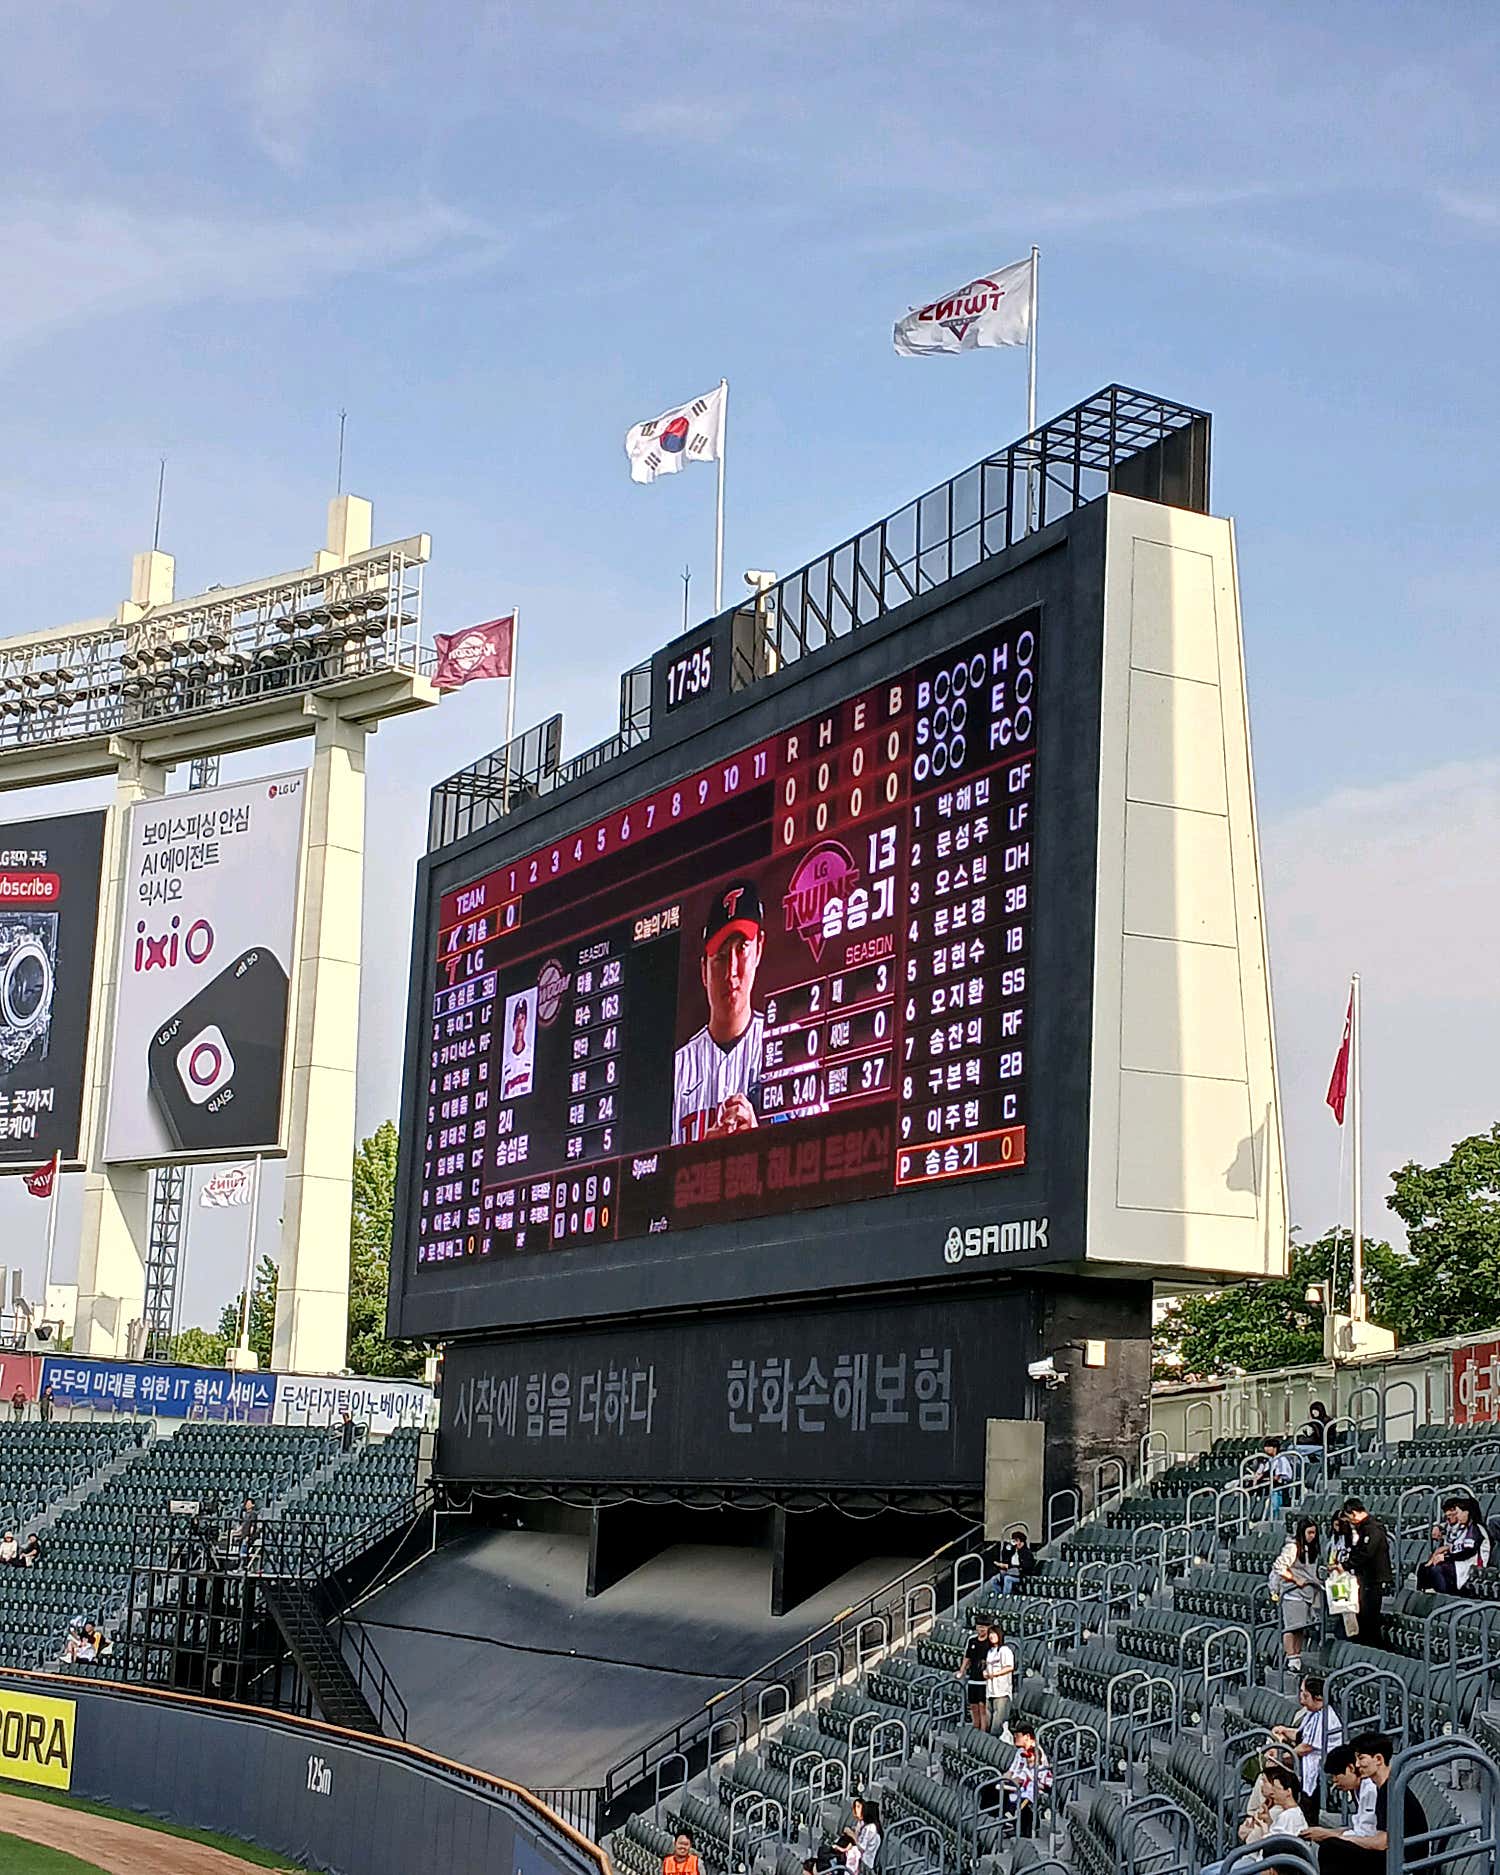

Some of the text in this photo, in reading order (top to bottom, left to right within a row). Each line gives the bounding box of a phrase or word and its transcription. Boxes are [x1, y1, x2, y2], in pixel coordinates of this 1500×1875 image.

[667, 646, 711, 705] 17:35
[917, 643, 1008, 710] B H
[916, 682, 1005, 745] S E
[914, 717, 1012, 781] O FC
[456, 686, 902, 916] TEAM 1 2 3 4 5 6 7 8 9 10 11 R H E B
[914, 763, 1032, 827] 1 박해민 CF
[142, 805, 250, 846] 보이스피싱 안심
[466, 731, 900, 944] 키움 0 0 0 0 0
[911, 803, 1028, 866] 2 문성주 LF
[0, 850, 47, 867] G전자 구독
[140, 842, 220, 877] AI 에이전트
[868, 825, 897, 874] 13
[466, 772, 898, 975] LG 0 0 0 0
[813, 861, 829, 881] LG
[910, 842, 1029, 904] 3 오스틴 DH
[139, 878, 183, 906] 익시오
[822, 875, 895, 938] 송승기
[633, 905, 681, 942] 오늘의 기록
[908, 885, 1027, 942] 4 문보경 3B
[845, 934, 893, 965] SEASON
[907, 926, 1023, 981] 5 김현수 1B
[876, 964, 887, 993] 3
[905, 967, 1025, 1022] 6 오지환 SS
[436, 997, 441, 1013] 1
[601, 994, 619, 1020] 163
[767, 985, 820, 1024] 승 2
[433, 1024, 440, 1041] 2
[603, 1026, 617, 1050] 41
[874, 1010, 886, 1038] 0
[905, 1009, 1023, 1061] 7 송찬의 RF
[432, 1051, 438, 1069] 3
[765, 1029, 818, 1067] 홀드 0
[430, 1079, 437, 1095] 4
[606, 1061, 616, 1084] 8
[861, 1058, 884, 1089] 37
[903, 1051, 1022, 1100] 8 구본혁 2B
[12, 1087, 55, 1114] 곳까지
[207, 1089, 235, 1113] 익시오
[598, 1095, 614, 1121] 24
[763, 1074, 816, 1110] ERA 3.40
[428, 1106, 435, 1124] 5
[498, 1108, 514, 1135] 24
[902, 1094, 1016, 1140] 9 이주헌 C
[426, 1133, 433, 1152] 6
[496, 1134, 529, 1167] 송성문
[567, 1128, 612, 1160] 도루 5
[900, 1136, 1012, 1179] P 송승기 0
[424, 1162, 431, 1179] 7
[632, 1154, 658, 1180] Speed
[422, 1189, 429, 1207] 8
[471, 1178, 480, 1197] C
[571, 1176, 611, 1202] 0 0
[421, 1218, 427, 1235] 9
[570, 1207, 609, 1233] 0 0
[965, 1218, 1048, 1257] SAMIK
[418, 1246, 425, 1263] P
[468, 1235, 475, 1254] 0
[49, 1368, 269, 1408] 모두의 미래를 위한 IT 혁신 서비스
[281, 1385, 425, 1420] 두산디지털이노베이션
[453, 1365, 657, 1438] 시작에 힘을 더하다
[726, 1347, 953, 1433] 한화손해보험
[0, 1711, 68, 1769] ORA
[306, 1754, 333, 1797] 125m
